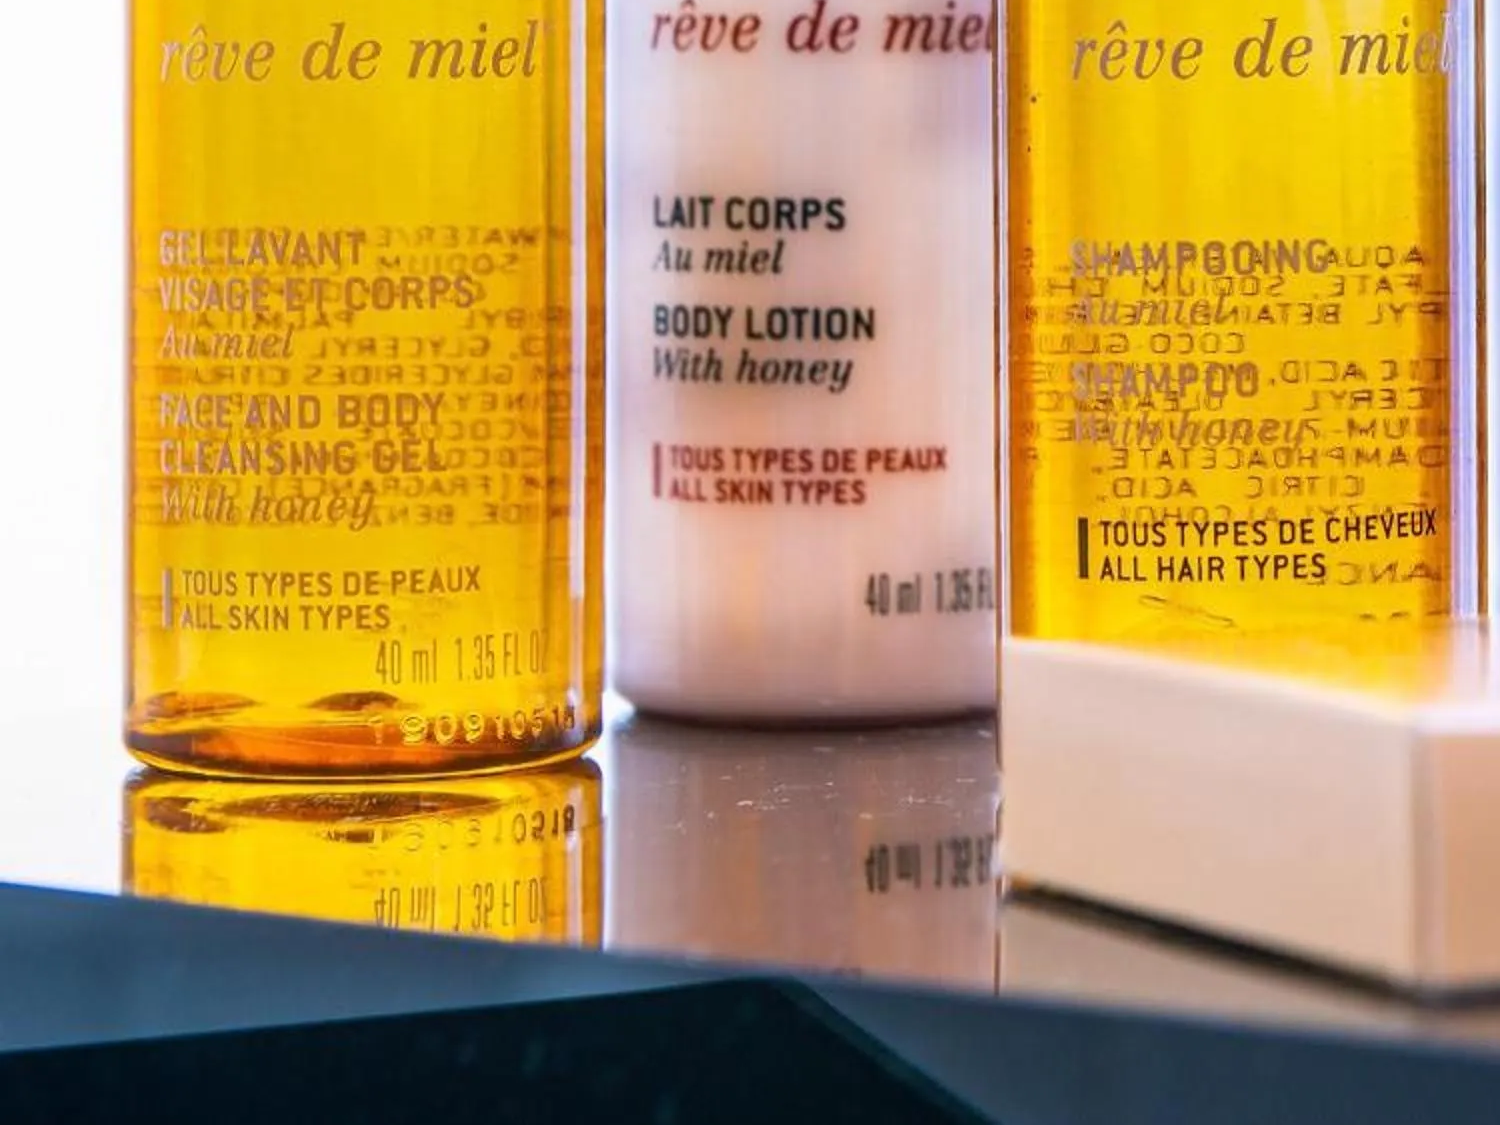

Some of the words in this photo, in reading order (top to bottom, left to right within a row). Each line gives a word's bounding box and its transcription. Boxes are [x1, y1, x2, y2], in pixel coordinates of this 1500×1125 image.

[160, 24, 275, 82] rêve
[302, 23, 381, 81] de
[407, 20, 539, 79] miel
[1072, 20, 1204, 81] rêve
[1233, 17, 1314, 79] de
[1339, 10, 1456, 76] miel
[653, 195, 714, 229] LAIT
[725, 197, 846, 231] CORPS
[159, 231, 209, 266] GEL
[224, 230, 366, 266] LAVANT
[653, 239, 692, 273] Au
[703, 239, 785, 275] miel
[1069, 239, 1328, 277] SHAMPOOING
[160, 277, 270, 312] VISAGE
[285, 277, 330, 312] ET
[344, 275, 475, 311] CORPS
[1135, 293, 1229, 326] miel
[161, 324, 199, 359] Au
[211, 325, 294, 359] miel
[653, 305, 733, 338] BODY
[745, 307, 876, 341] LOTION
[653, 347, 723, 383] With
[735, 349, 854, 393] honey
[1071, 362, 1259, 399] SHAMPOO
[159, 393, 240, 429] FACE
[245, 394, 322, 430] AND
[337, 393, 446, 429] BODY
[1175, 409, 1307, 449] honey
[159, 439, 357, 477] CLEANSING
[371, 439, 448, 475] GEL
[671, 445, 724, 471] TOUS
[733, 448, 813, 473] TYPES
[822, 448, 857, 473] DE
[866, 447, 947, 472] PEAUX
[159, 484, 236, 524] With
[250, 487, 377, 531] honey
[669, 478, 706, 503] ALL
[714, 479, 774, 504] SKIN
[782, 479, 867, 505] TYPES
[1101, 520, 1167, 548] TOUS
[1176, 519, 1268, 548] TYPES
[1279, 518, 1314, 545] DE
[1325, 510, 1437, 543] CHEVEUX
[182, 570, 239, 597] TOUS
[246, 571, 333, 598] TYPES
[343, 570, 381, 597] DE
[390, 565, 480, 594] PEAUX
[1100, 557, 1147, 581] ALL
[1157, 555, 1225, 582] HAIR
[1236, 553, 1327, 582] TYPES
[865, 572, 890, 616] 40
[182, 605, 222, 631] ALL
[229, 604, 290, 631] SKIN
[300, 604, 391, 630] TYPES
[376, 639, 401, 685] 40
[412, 638, 437, 683] ml
[455, 634, 495, 681] 1.35
[504, 632, 522, 676] FL
